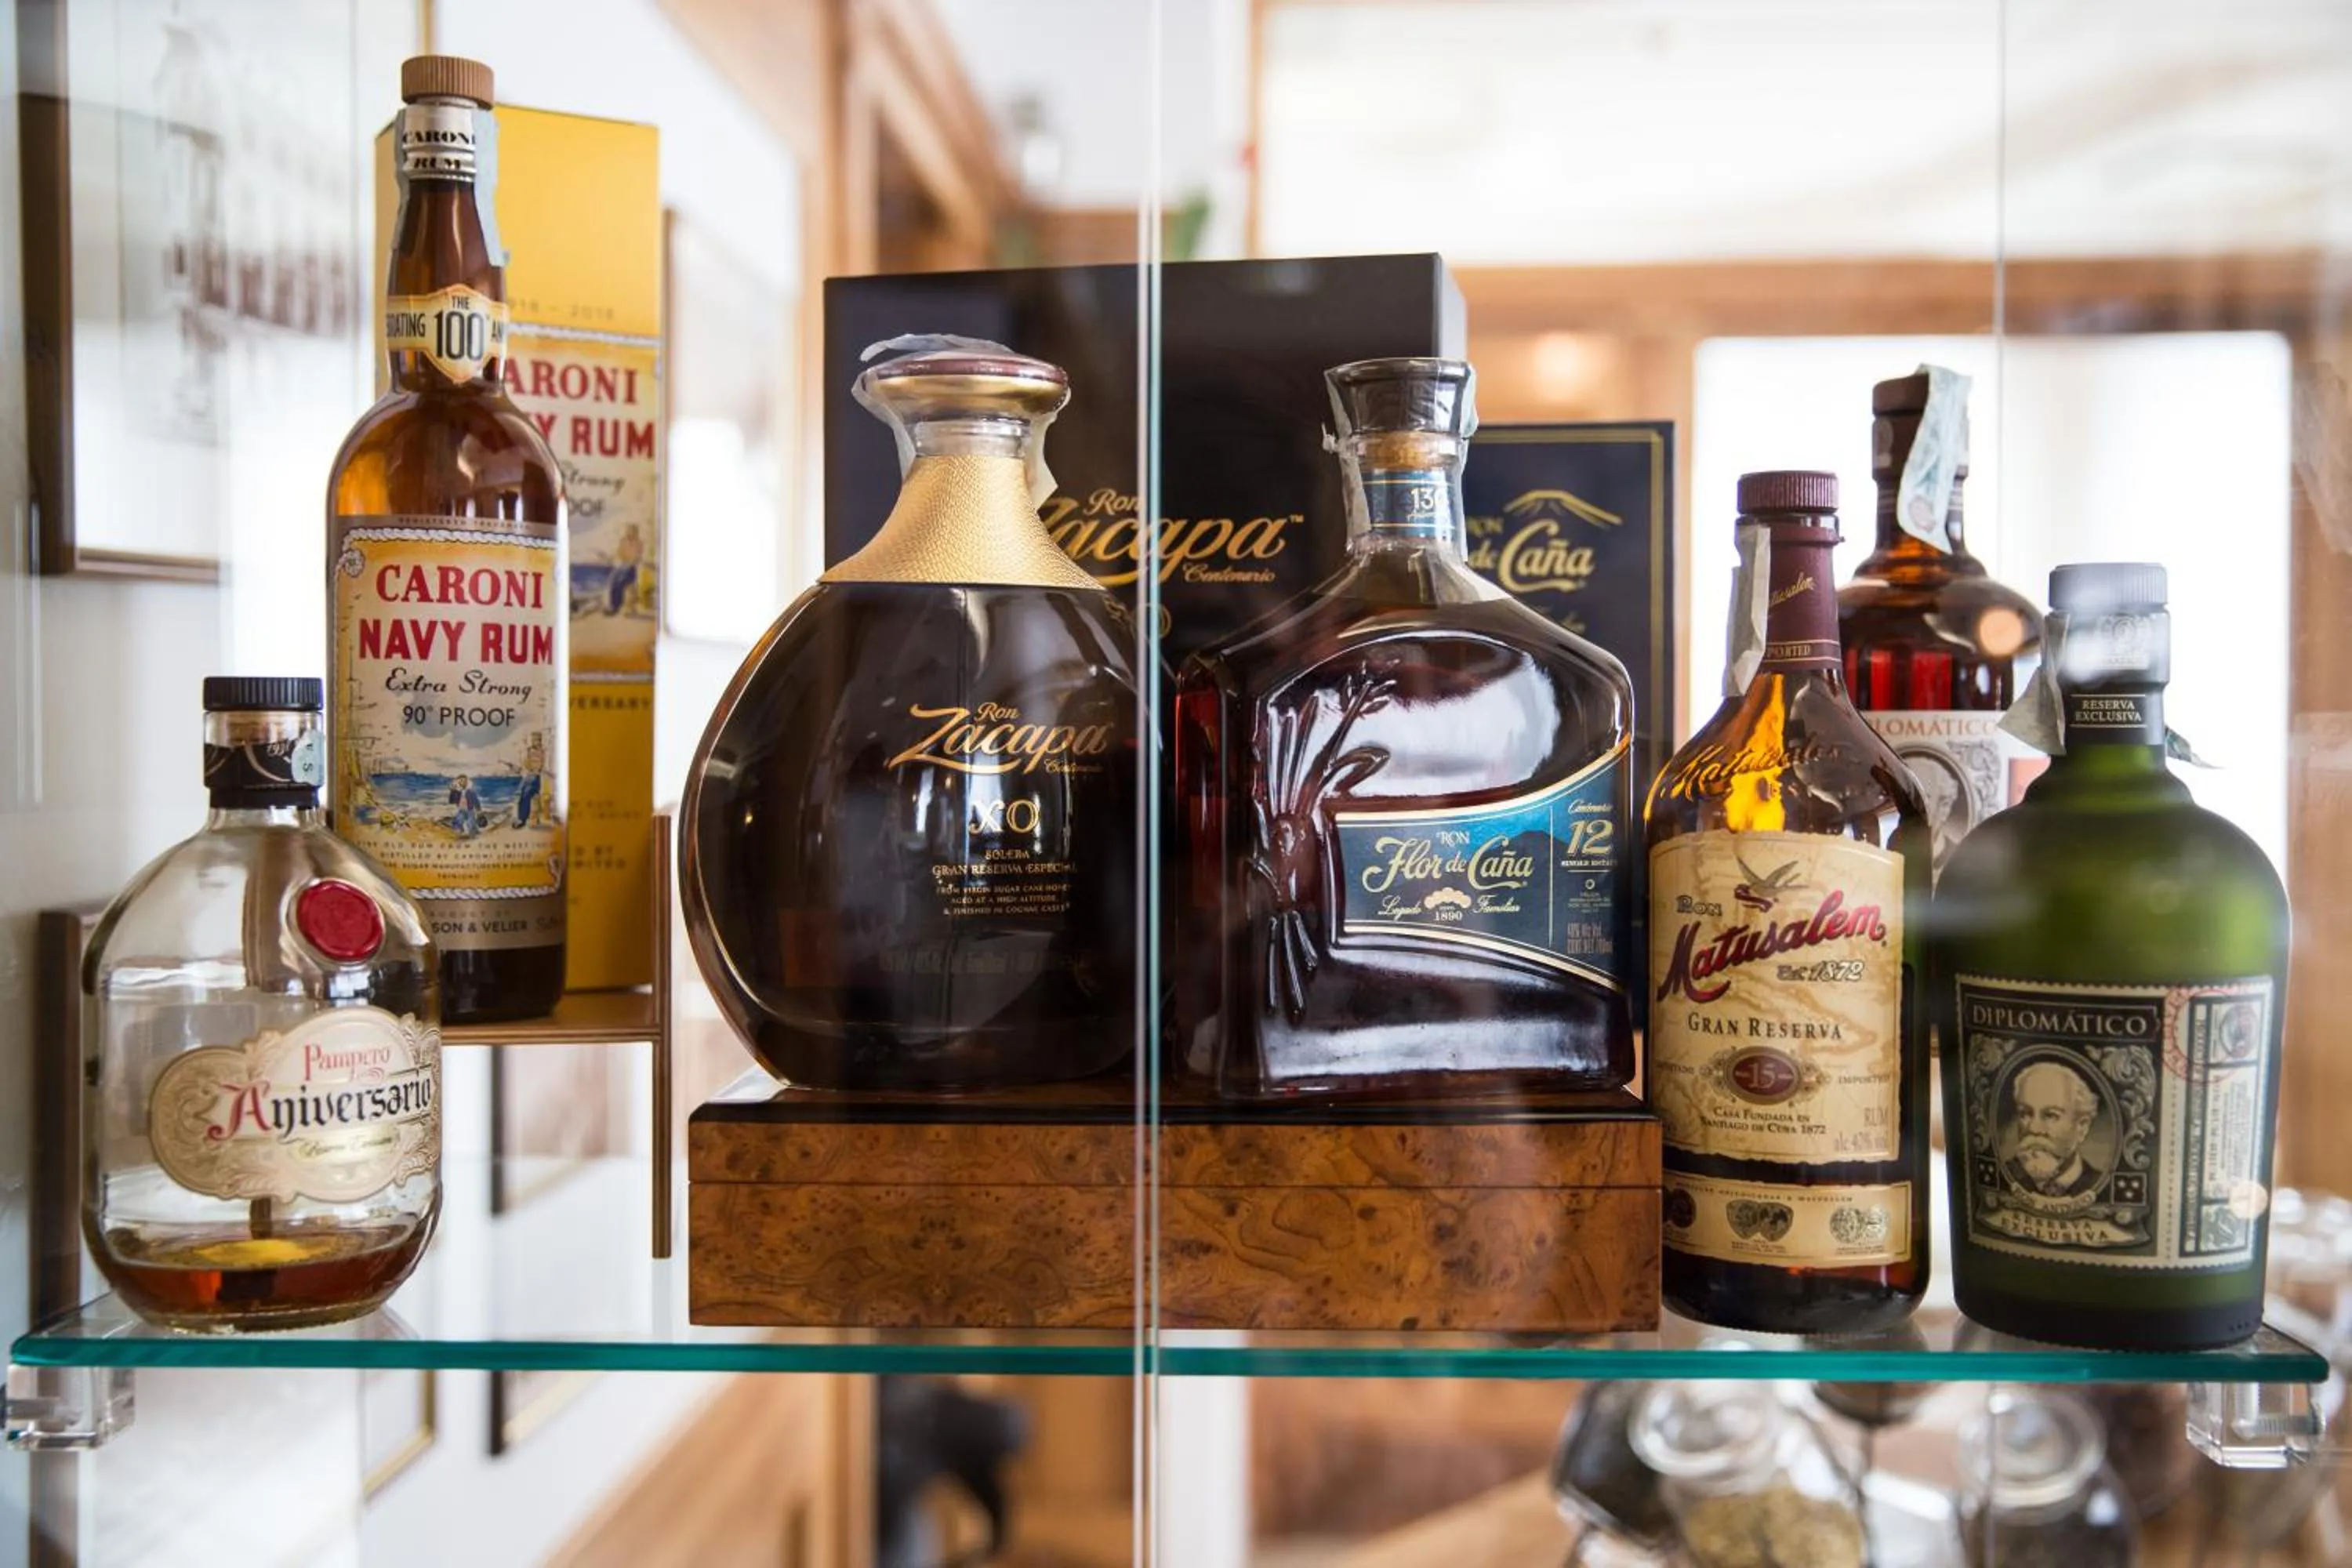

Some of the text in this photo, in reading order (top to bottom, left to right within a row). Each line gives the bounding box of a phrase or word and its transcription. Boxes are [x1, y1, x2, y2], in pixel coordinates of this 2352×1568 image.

[402, 130, 475, 144] CARONI
[414, 158, 461, 169] RUM
[452, 296, 470, 310] THE
[434, 311, 484, 360] 100
[506, 358, 638, 405] ARONI
[572, 415, 654, 459] RUM
[1498, 518, 1597, 593] Caña
[1182, 563, 1276, 583] Centenario
[376, 564, 543, 609] CARONI
[359, 618, 553, 666] NAVY RUM
[1766, 644, 1811, 659] PORTED
[385, 667, 532, 704] Extra Strong
[975, 702, 1019, 722] Ron
[2075, 711, 2142, 722] EXCLUSIVA
[2082, 699, 2135, 710] RESERVA
[440, 707, 515, 728] PROOF
[1873, 714, 1997, 737] LOMÁTICO
[883, 704, 1107, 775] Zacapa
[968, 800, 1040, 834] XO
[1439, 830, 1470, 847] RON
[1567, 819, 1613, 857] 12
[985, 848, 1029, 860] SOLERA
[1363, 834, 1534, 893] Flor de Caña
[932, 865, 967, 876] GRAN
[431, 920, 463, 934] SON
[481, 919, 528, 933] VELIER
[1434, 911, 1463, 921] 1890
[1656, 891, 1887, 1004] Matusalem
[1807, 960, 1864, 981] 1872
[1688, 1011, 1842, 1040] GRAN RESERVA
[1973, 1004, 2147, 1036] DIPLOMÁTICO
[303, 1044, 390, 1082] Pampero
[1748, 1062, 1775, 1090] 15
[207, 1075, 432, 1144] Aniversario
[1801, 1124, 1826, 1134] 1872
